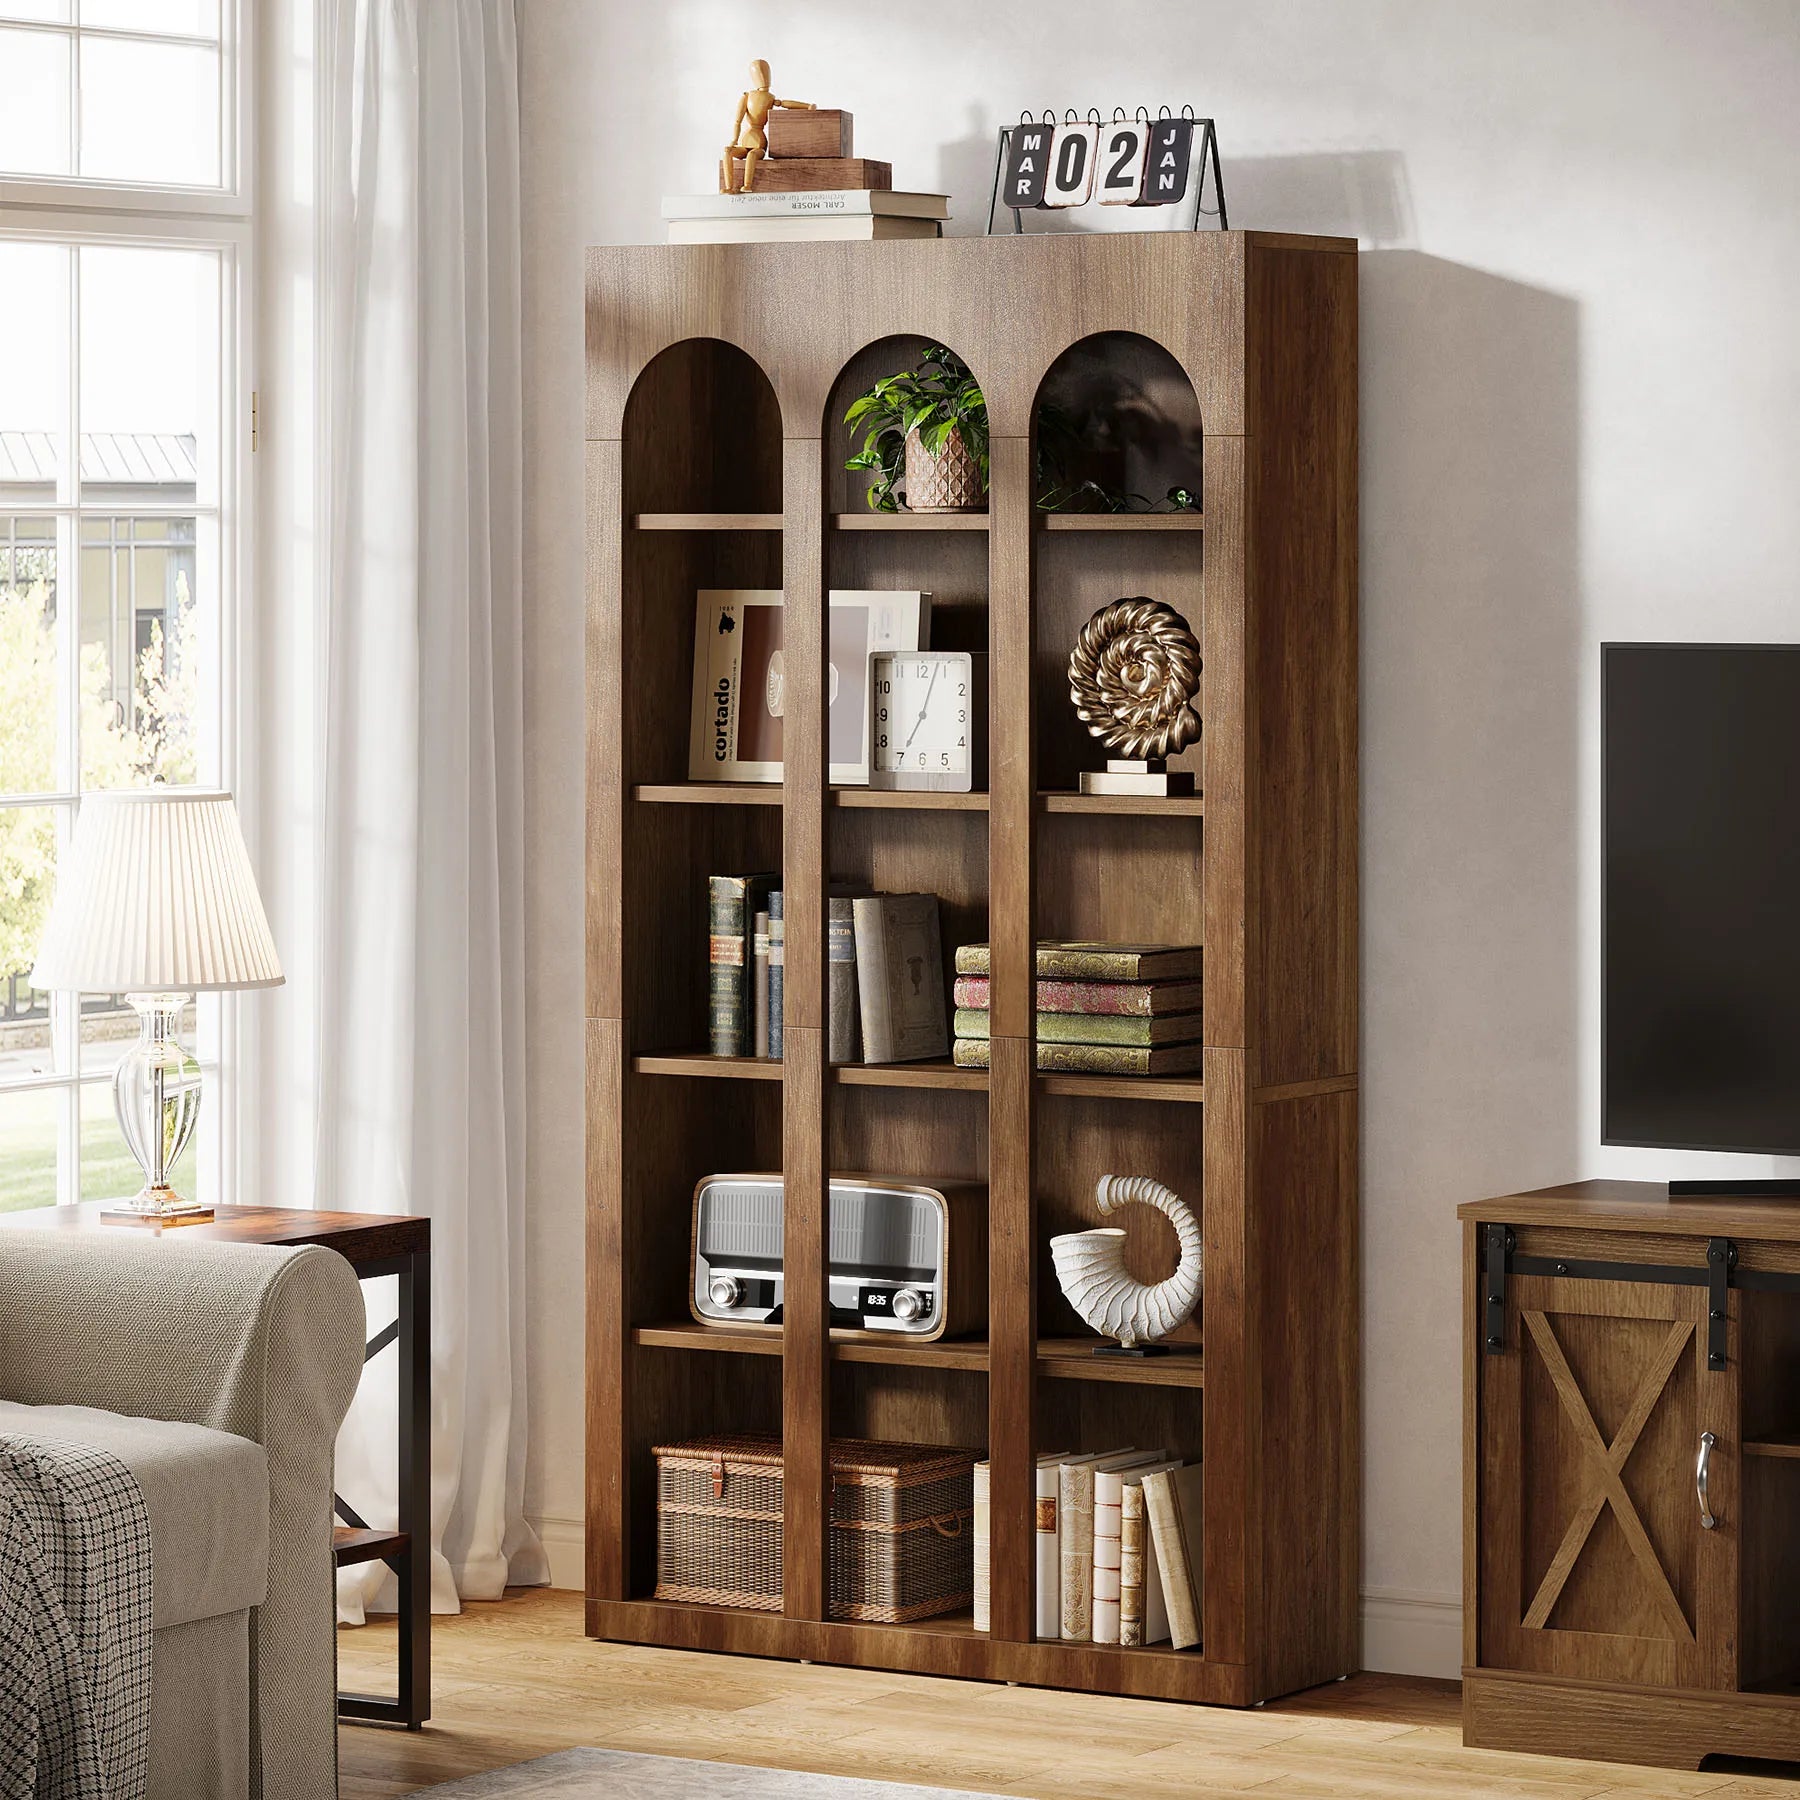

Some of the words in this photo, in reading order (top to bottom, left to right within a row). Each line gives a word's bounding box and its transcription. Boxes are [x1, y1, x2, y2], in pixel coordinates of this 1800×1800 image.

[1016, 134, 1042, 195] MAR
[1158, 129, 1177, 190] JAN
[824, 201, 845, 209] CARL
[895, 664, 904, 678] 11
[916, 665, 929, 678] 12
[879, 680, 891, 694] 10
[957, 683, 966, 696] 2
[714, 677, 730, 762] cortado
[879, 708, 888, 721] 9
[957, 709, 966, 723] 3
[879, 734, 888, 748] 8
[957, 735, 966, 747] 4
[896, 752, 905, 765] 7
[919, 752, 927, 766] 6
[940, 752, 949, 766] 5
